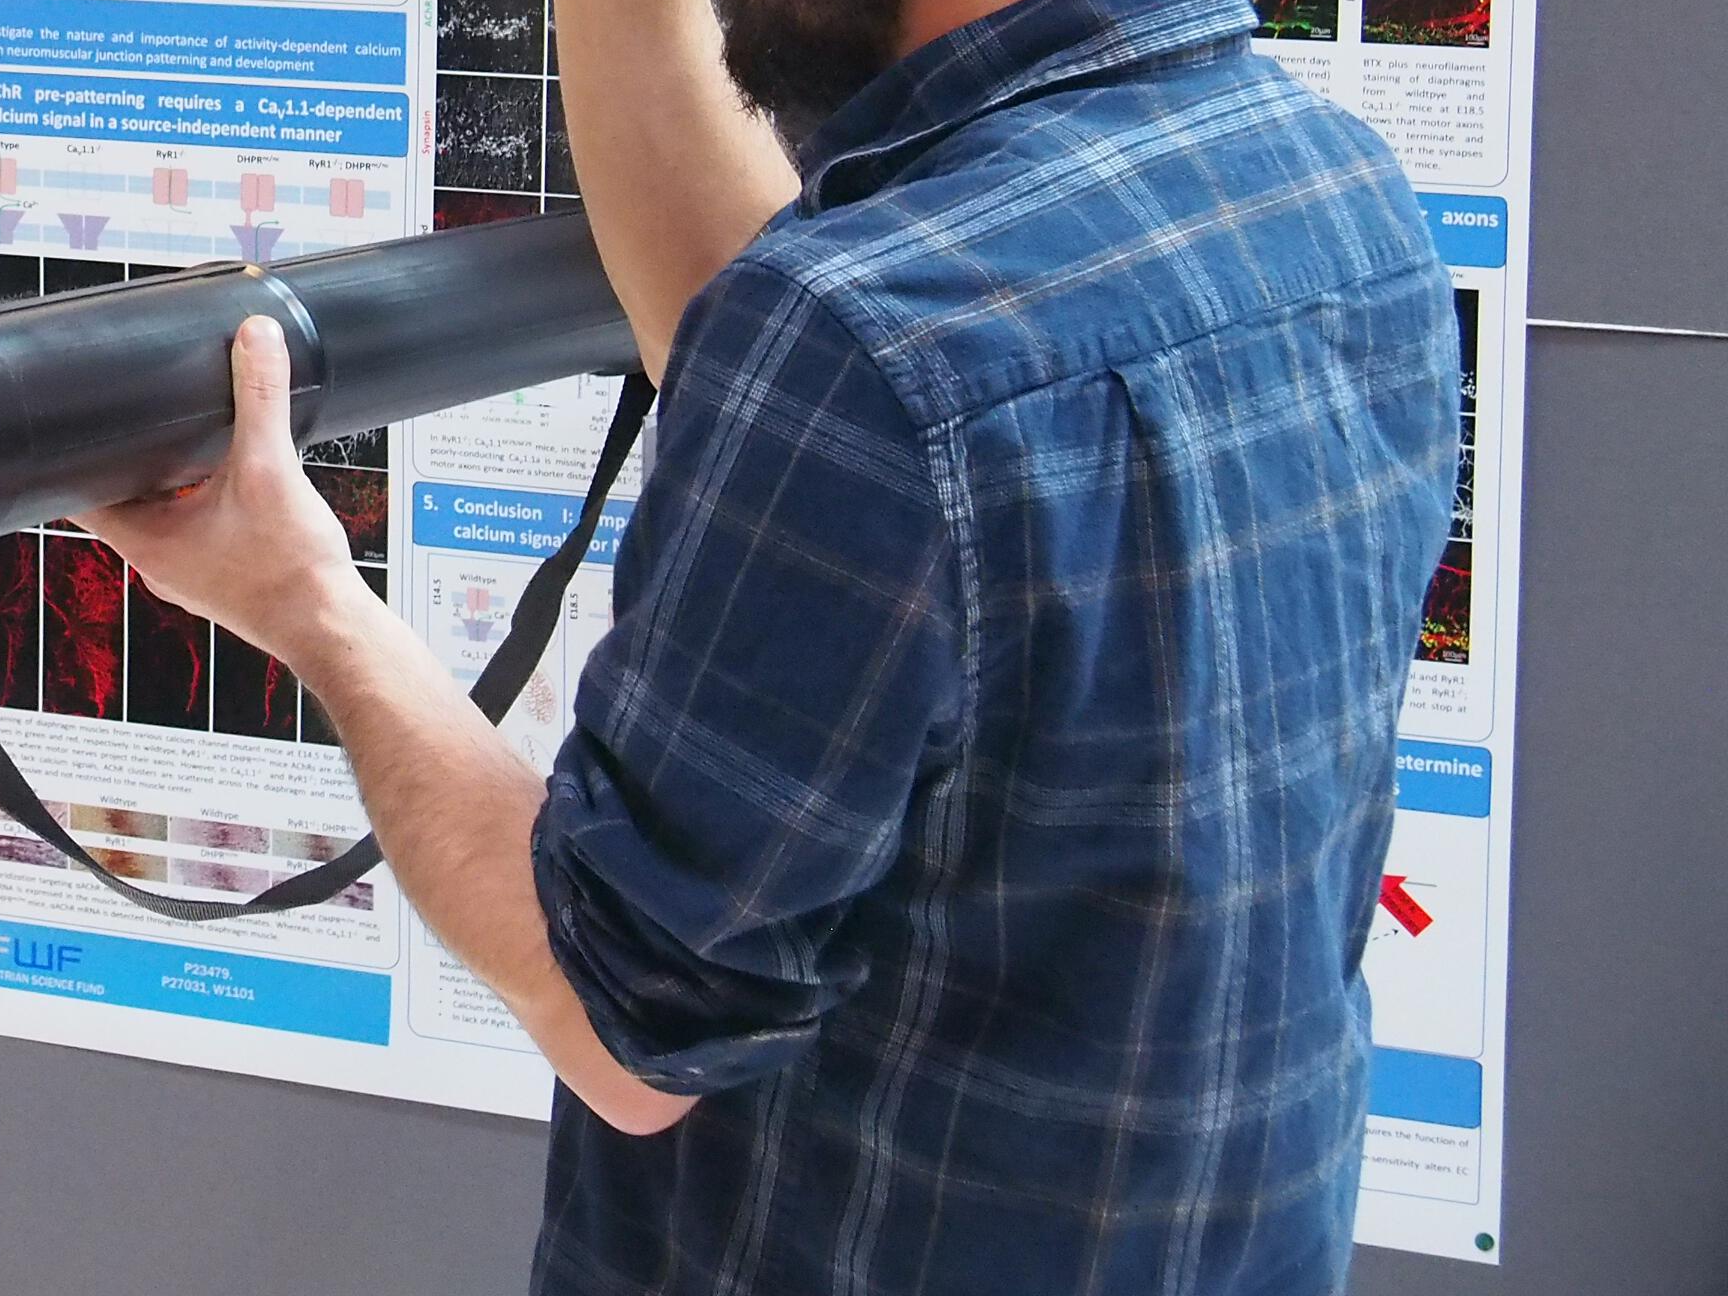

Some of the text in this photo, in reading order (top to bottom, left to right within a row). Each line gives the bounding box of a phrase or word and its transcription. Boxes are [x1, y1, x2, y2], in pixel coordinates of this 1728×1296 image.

[40, 28, 59, 40] the
[67, 31, 104, 42] nature
[112, 32, 133, 43] and
[141, 33, 208, 47] importance
[215, 36, 227, 48] of
[235, 39, 347, 54] activity-dependent
[355, 43, 401, 56] calcium
[35, 89, 144, 109] pre-patterning
[158, 95, 221, 111] requires
[236, 100, 244, 112] a
[43, 111, 85, 129] signal
[90, 113, 104, 128] in
[108, 118, 117, 129] a
[121, 118, 276, 139] source-independent
[281, 128, 342, 142] manner
[1442, 212, 1498, 227] axons
[424, 495, 572, 523] 5. Conclusion I:
[454, 524, 515, 543] calcium
[520, 530, 567, 549] signal
[589, 538, 608, 553] or
[1396, 755, 1483, 777] etermine
[31, 975, 74, 990] SCIENCE
[76, 982, 104, 995] FUND
